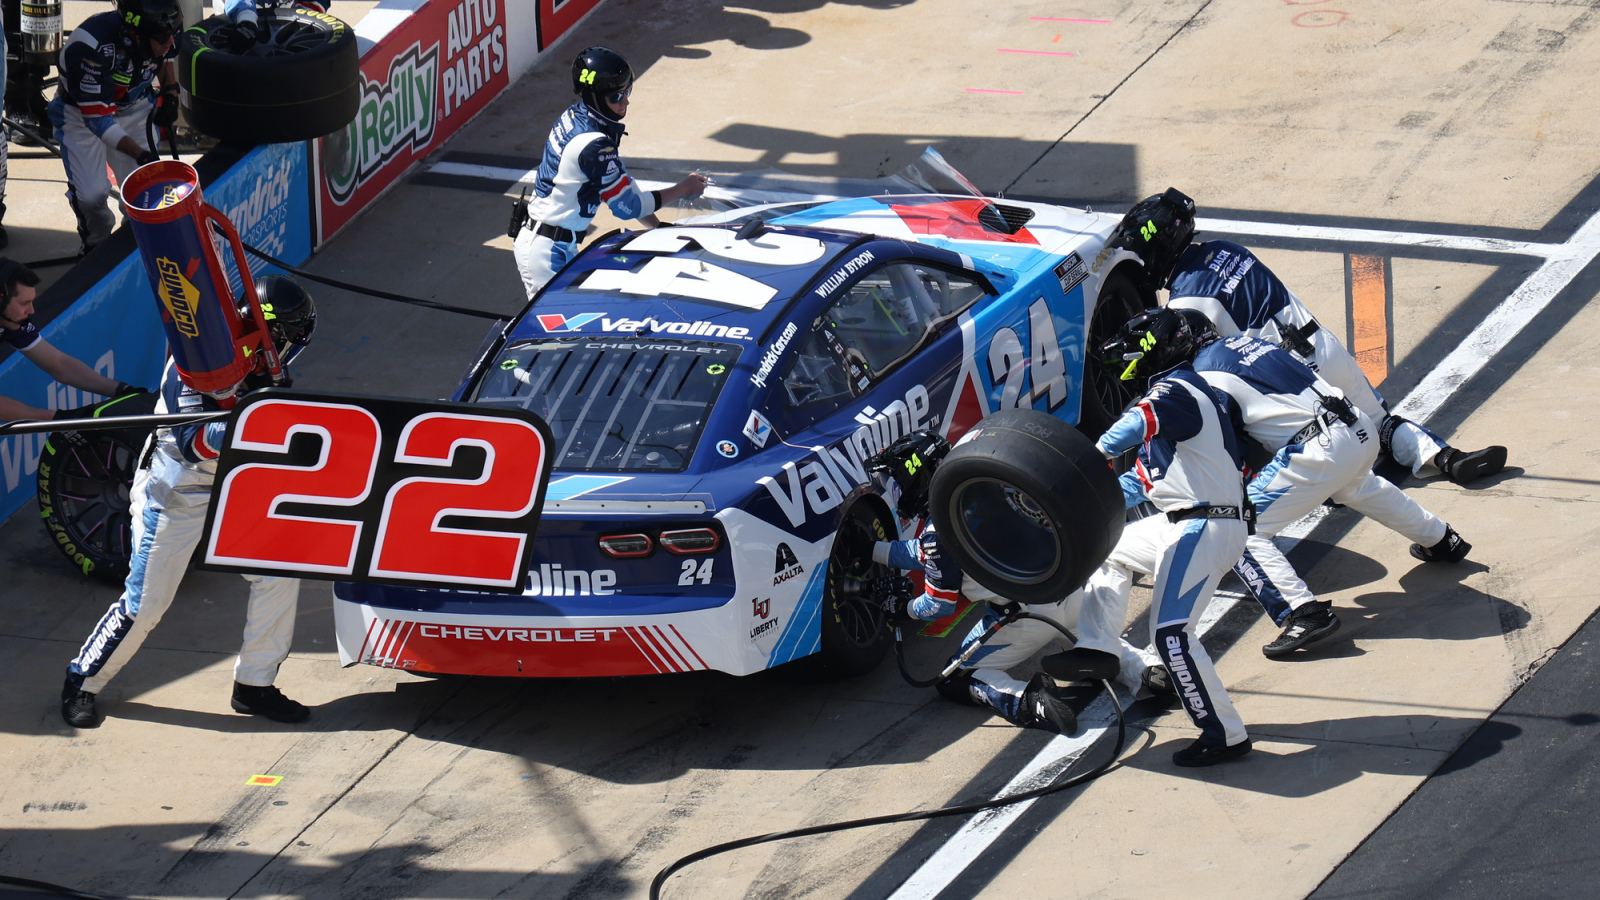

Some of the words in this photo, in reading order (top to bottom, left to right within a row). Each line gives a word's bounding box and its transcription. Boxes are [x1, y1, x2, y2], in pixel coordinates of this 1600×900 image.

[125, 11, 141, 27] 24
[448, 0, 496, 61] AUTO
[443, 24, 504, 118] PARTS
[579, 69, 596, 85] 24
[332, 64, 432, 187] OReilly
[1140, 219, 1157, 242] 24
[815, 267, 849, 299] WILLIAM
[844, 249, 876, 274] BYRON
[1219, 253, 1241, 280] Team
[1220, 256, 1256, 294] Valvoline
[159, 259, 197, 336] SUNOCO
[260, 302, 277, 321] 24
[601, 317, 750, 340] Valvoline
[1139, 330, 1157, 352] 24
[585, 342, 728, 355] CHEVROLET
[988, 295, 1068, 411] 24
[754, 384, 930, 528] Valvoline
[904, 452, 922, 476] 24
[204, 398, 546, 588] 22
[677, 558, 713, 587] 24
[773, 565, 804, 587] AXALTA
[80, 608, 126, 673] Valvoline
[419, 625, 618, 642] CHEVROLET
[750, 616, 779, 639] LIBERTY
[1165, 635, 1208, 720] Valvoline
